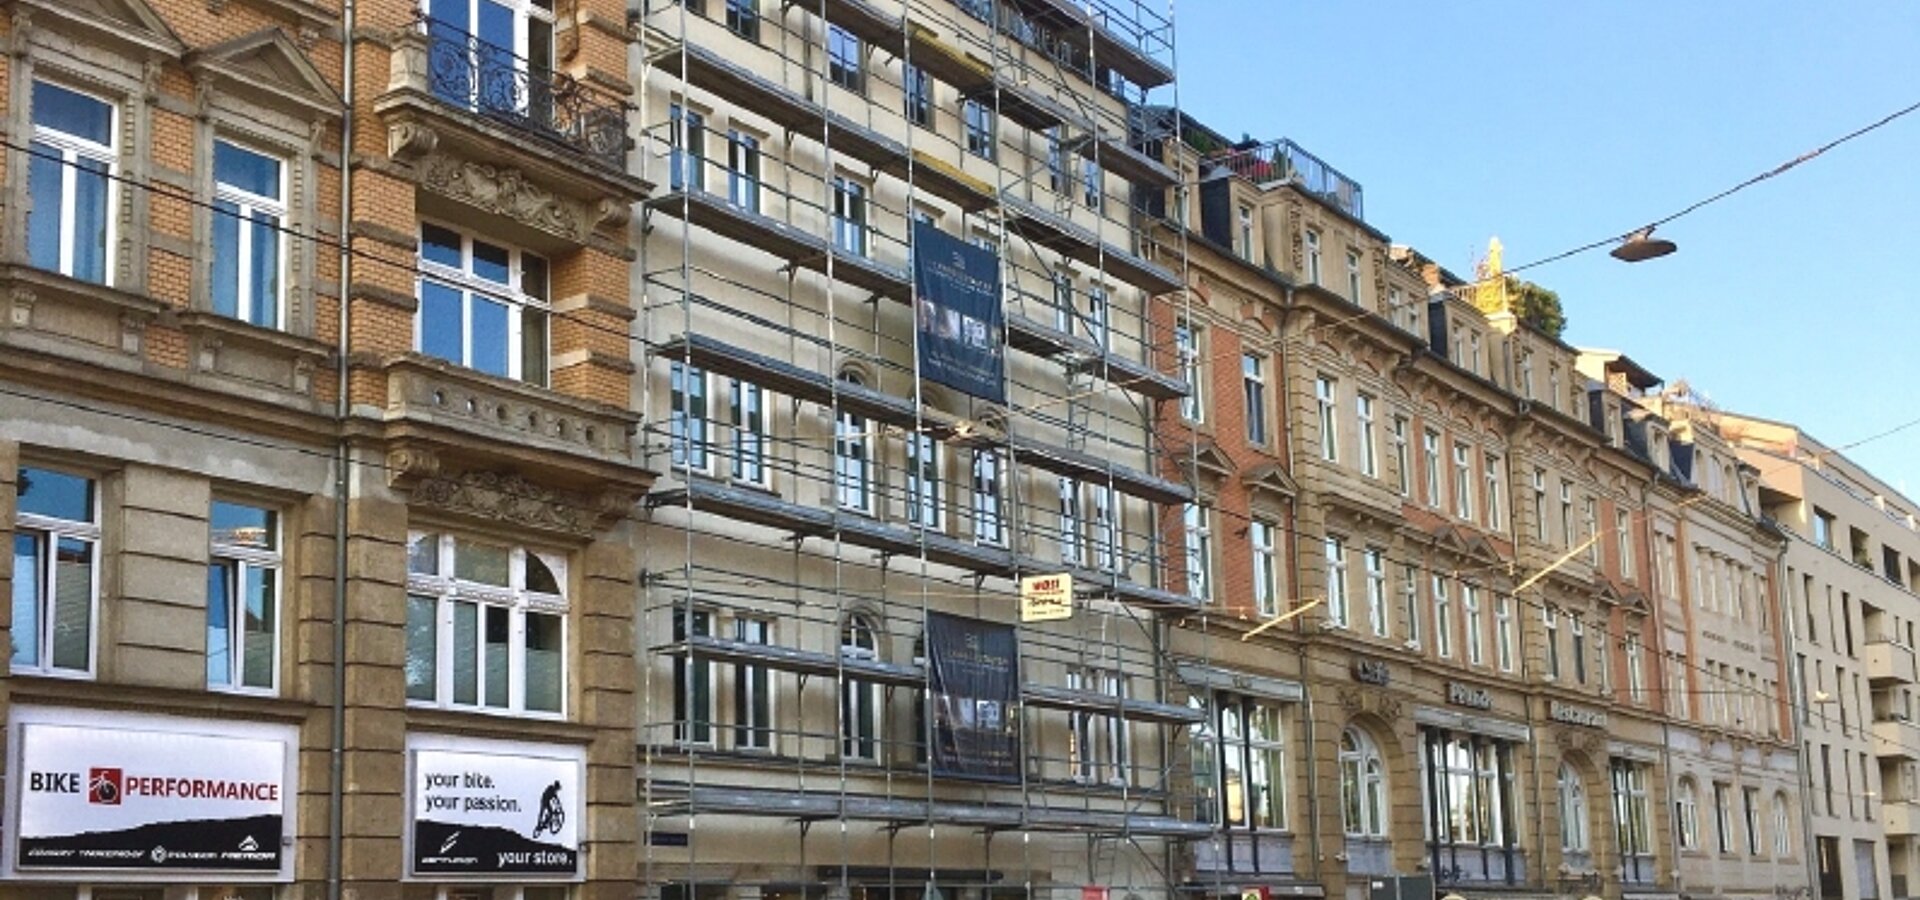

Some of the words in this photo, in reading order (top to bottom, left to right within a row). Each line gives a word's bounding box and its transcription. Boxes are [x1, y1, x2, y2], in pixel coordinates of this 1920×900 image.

[30, 772, 80, 794] BIKE
[125, 776, 279, 802] PERFORMANCE
[425, 773, 459, 790] your
[463, 771, 495, 789] bike.
[425, 795, 459, 812] your
[463, 795, 522, 813] passion.
[498, 852, 531, 868] your
[533, 850, 573, 865] store.
